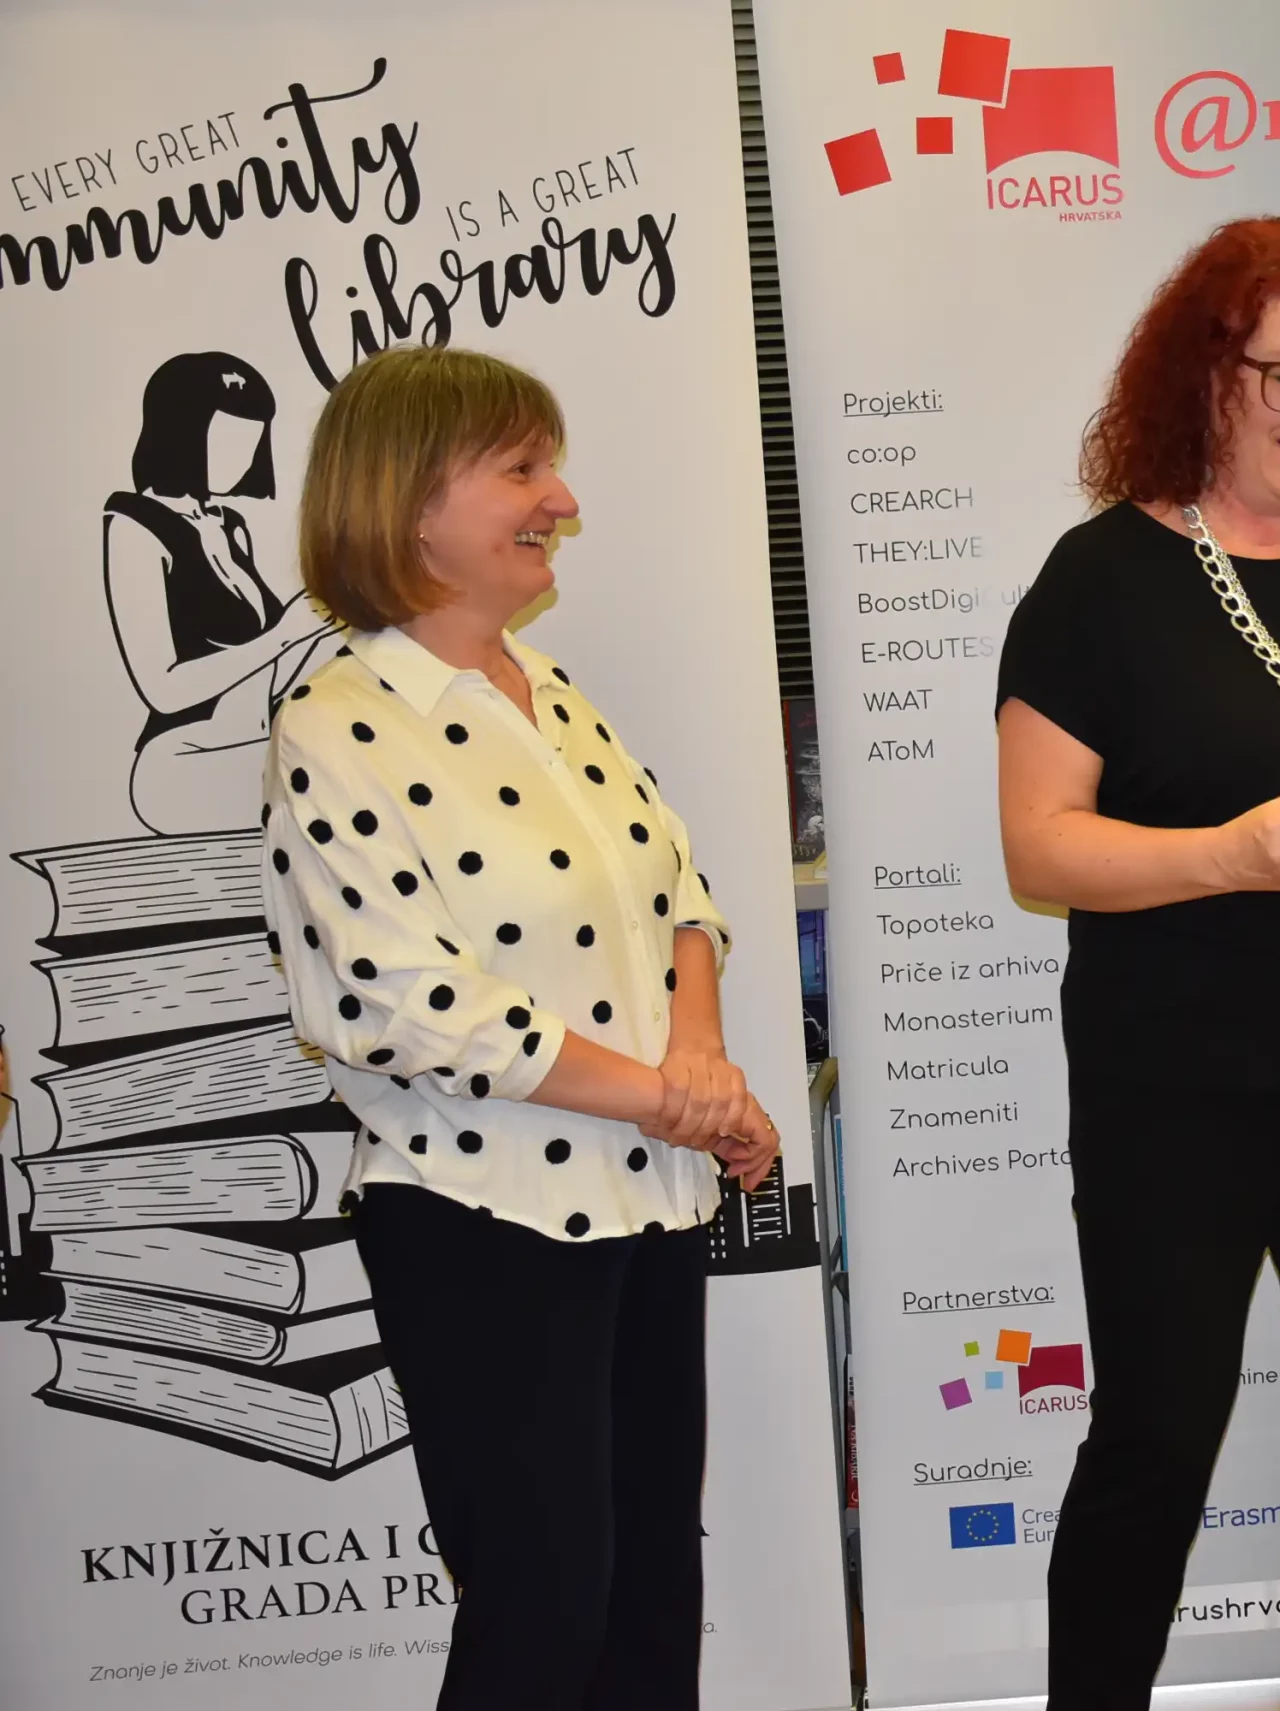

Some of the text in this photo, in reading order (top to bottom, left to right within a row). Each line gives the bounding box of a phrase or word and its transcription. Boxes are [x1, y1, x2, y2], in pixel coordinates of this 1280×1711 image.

[12, 112, 244, 212] EVERY GREAT
[446, 148, 642, 242] IS A GREAT
[986, 172, 1125, 210] ICARUS
[1058, 209, 1123, 223] HRVATSKA
[285, 213, 677, 394] library
[843, 388, 944, 418] Projekti:
[847, 445, 917, 466] co:op
[850, 487, 974, 514] CREARCH
[853, 536, 983, 563] THEY:LIVE
[861, 636, 995, 663] E-ROUTES
[863, 689, 933, 712] WAAT
[868, 739, 934, 762] AToM
[874, 863, 962, 888] Portali:
[877, 911, 994, 939] Topoteka
[881, 956, 1059, 983] Priče iz arhiva
[884, 1006, 1053, 1032] Monasterium
[887, 1055, 1009, 1080] Matricula
[890, 1102, 1018, 1129] Znameniti
[893, 1155, 999, 1177] Archives
[902, 1285, 1055, 1312] Partnerstva:
[1019, 1394, 1088, 1414] ICARUS
[914, 1456, 1033, 1483] Suradnje:
[80, 1527, 370, 1587] KNJIŽNICA
[384, 1524, 401, 1559] I
[181, 1578, 368, 1625] GRADA
[90, 1661, 156, 1682] Znanje
[160, 1659, 178, 1679] je
[183, 1657, 231, 1675] život.
[238, 1646, 344, 1671] Knowledge
[349, 1644, 363, 1660] is
[369, 1642, 398, 1659] life.
